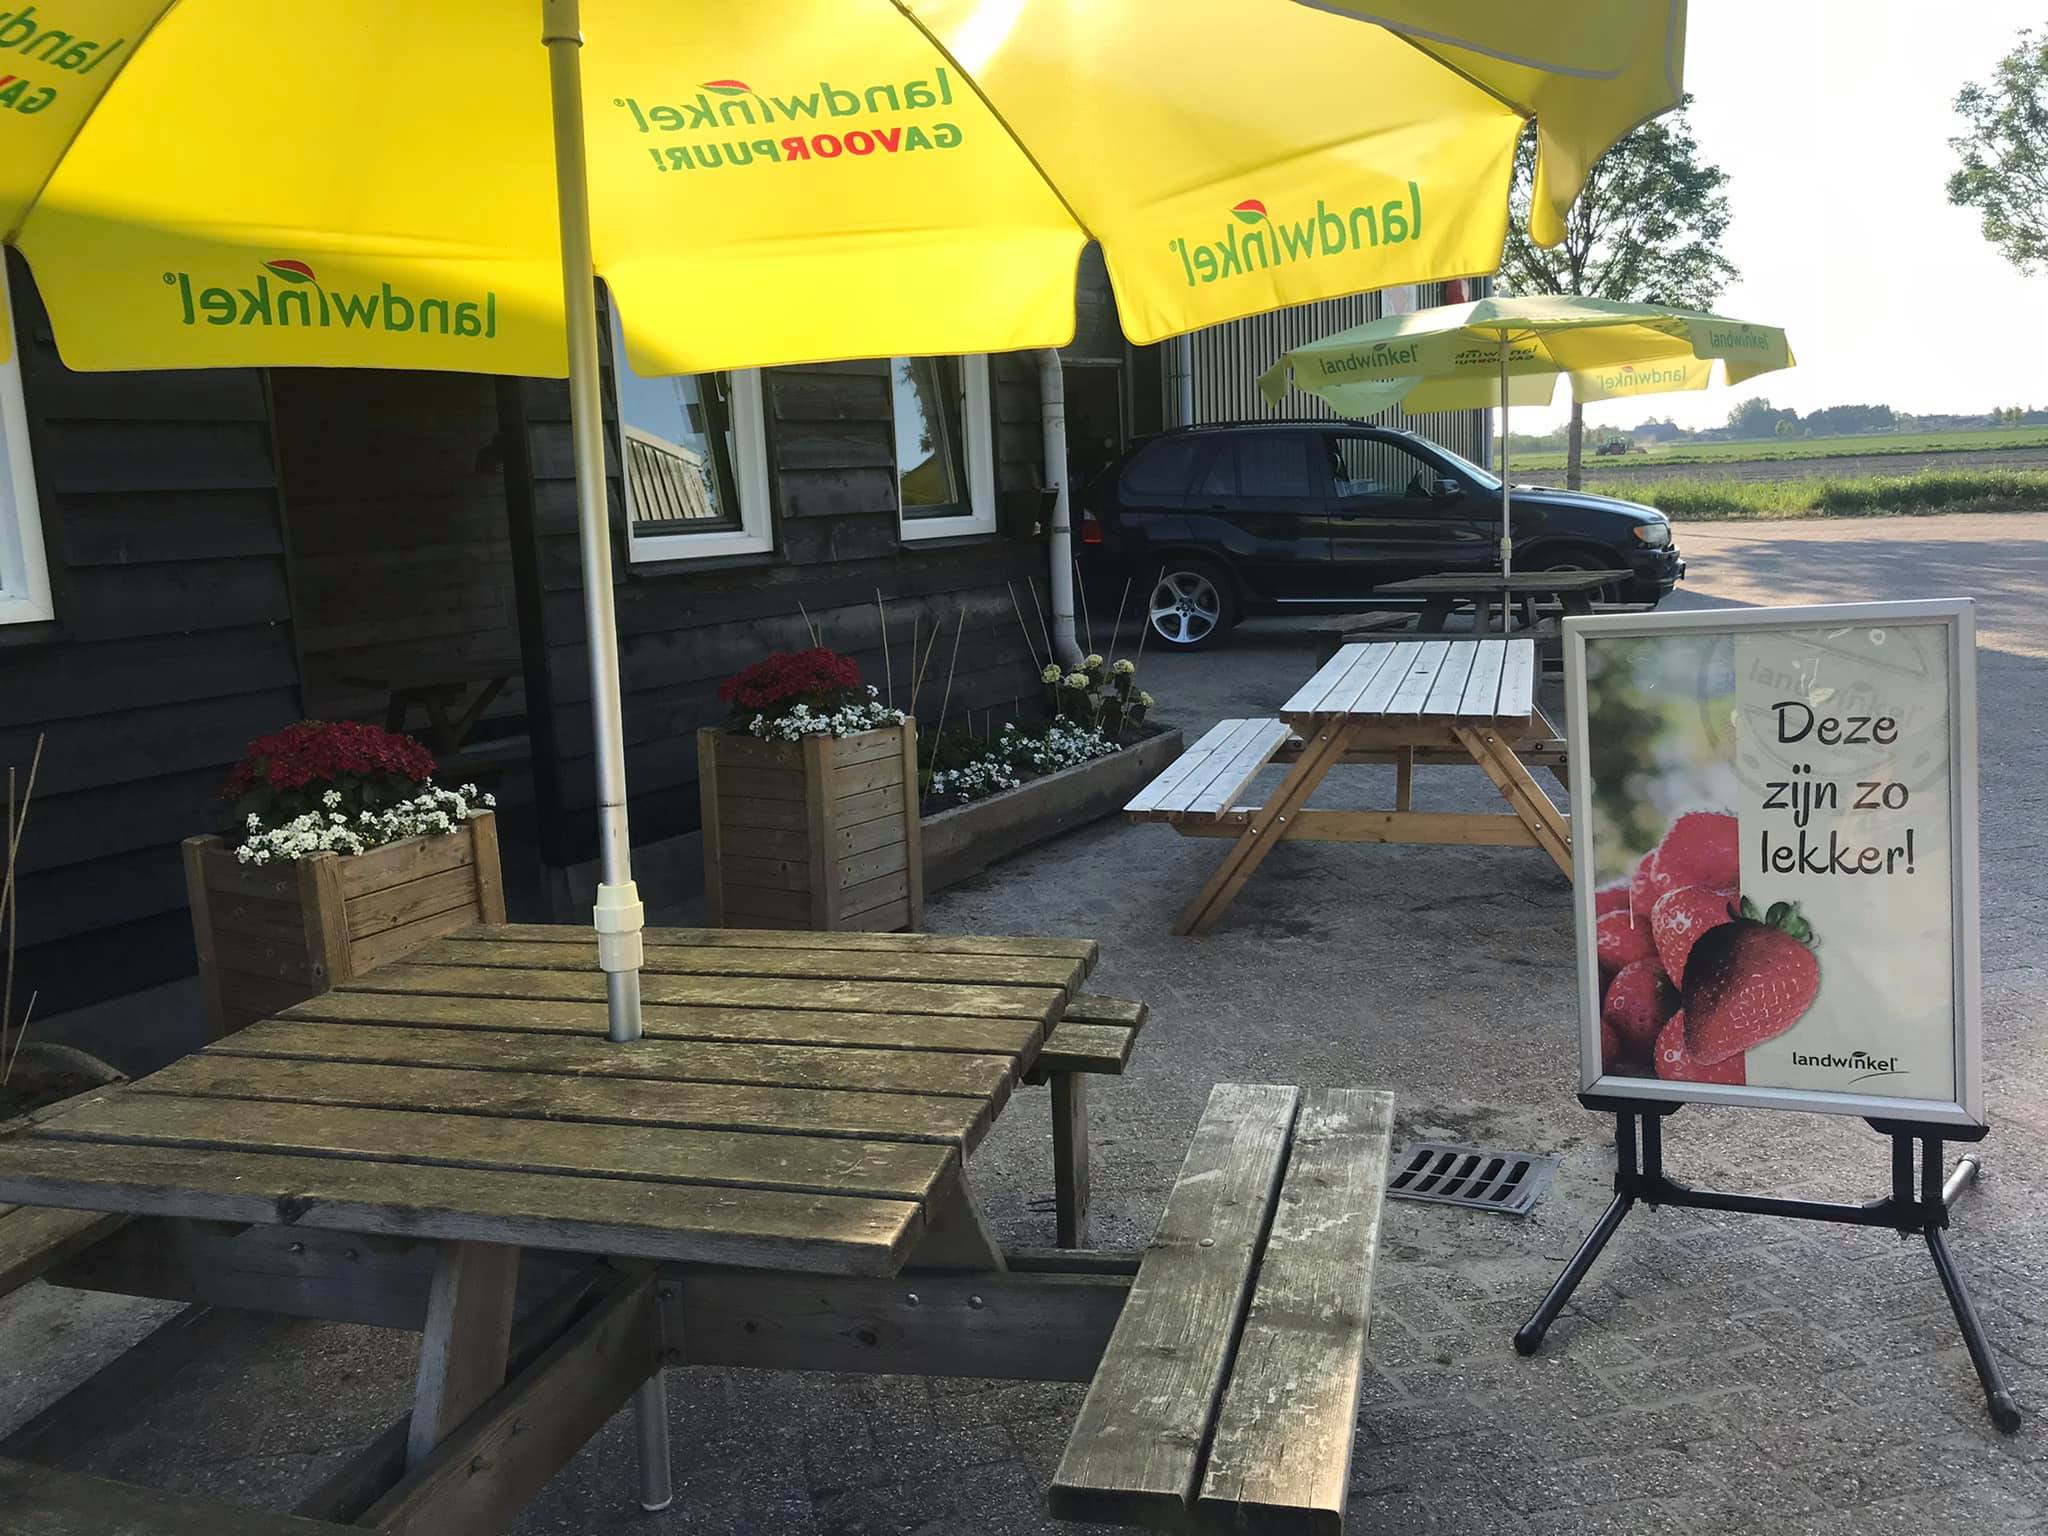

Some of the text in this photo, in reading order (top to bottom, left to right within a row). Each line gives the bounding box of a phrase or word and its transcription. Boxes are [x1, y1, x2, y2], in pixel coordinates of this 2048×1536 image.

[1710, 329, 1768, 351] landwinkel
[1319, 345, 1417, 376] landwinkel
[1771, 701, 1898, 745] Deze
[1762, 763, 1909, 827] zijn zo
[1761, 828, 1915, 875] lekker!
[1792, 1051, 1896, 1072] landwinkel
